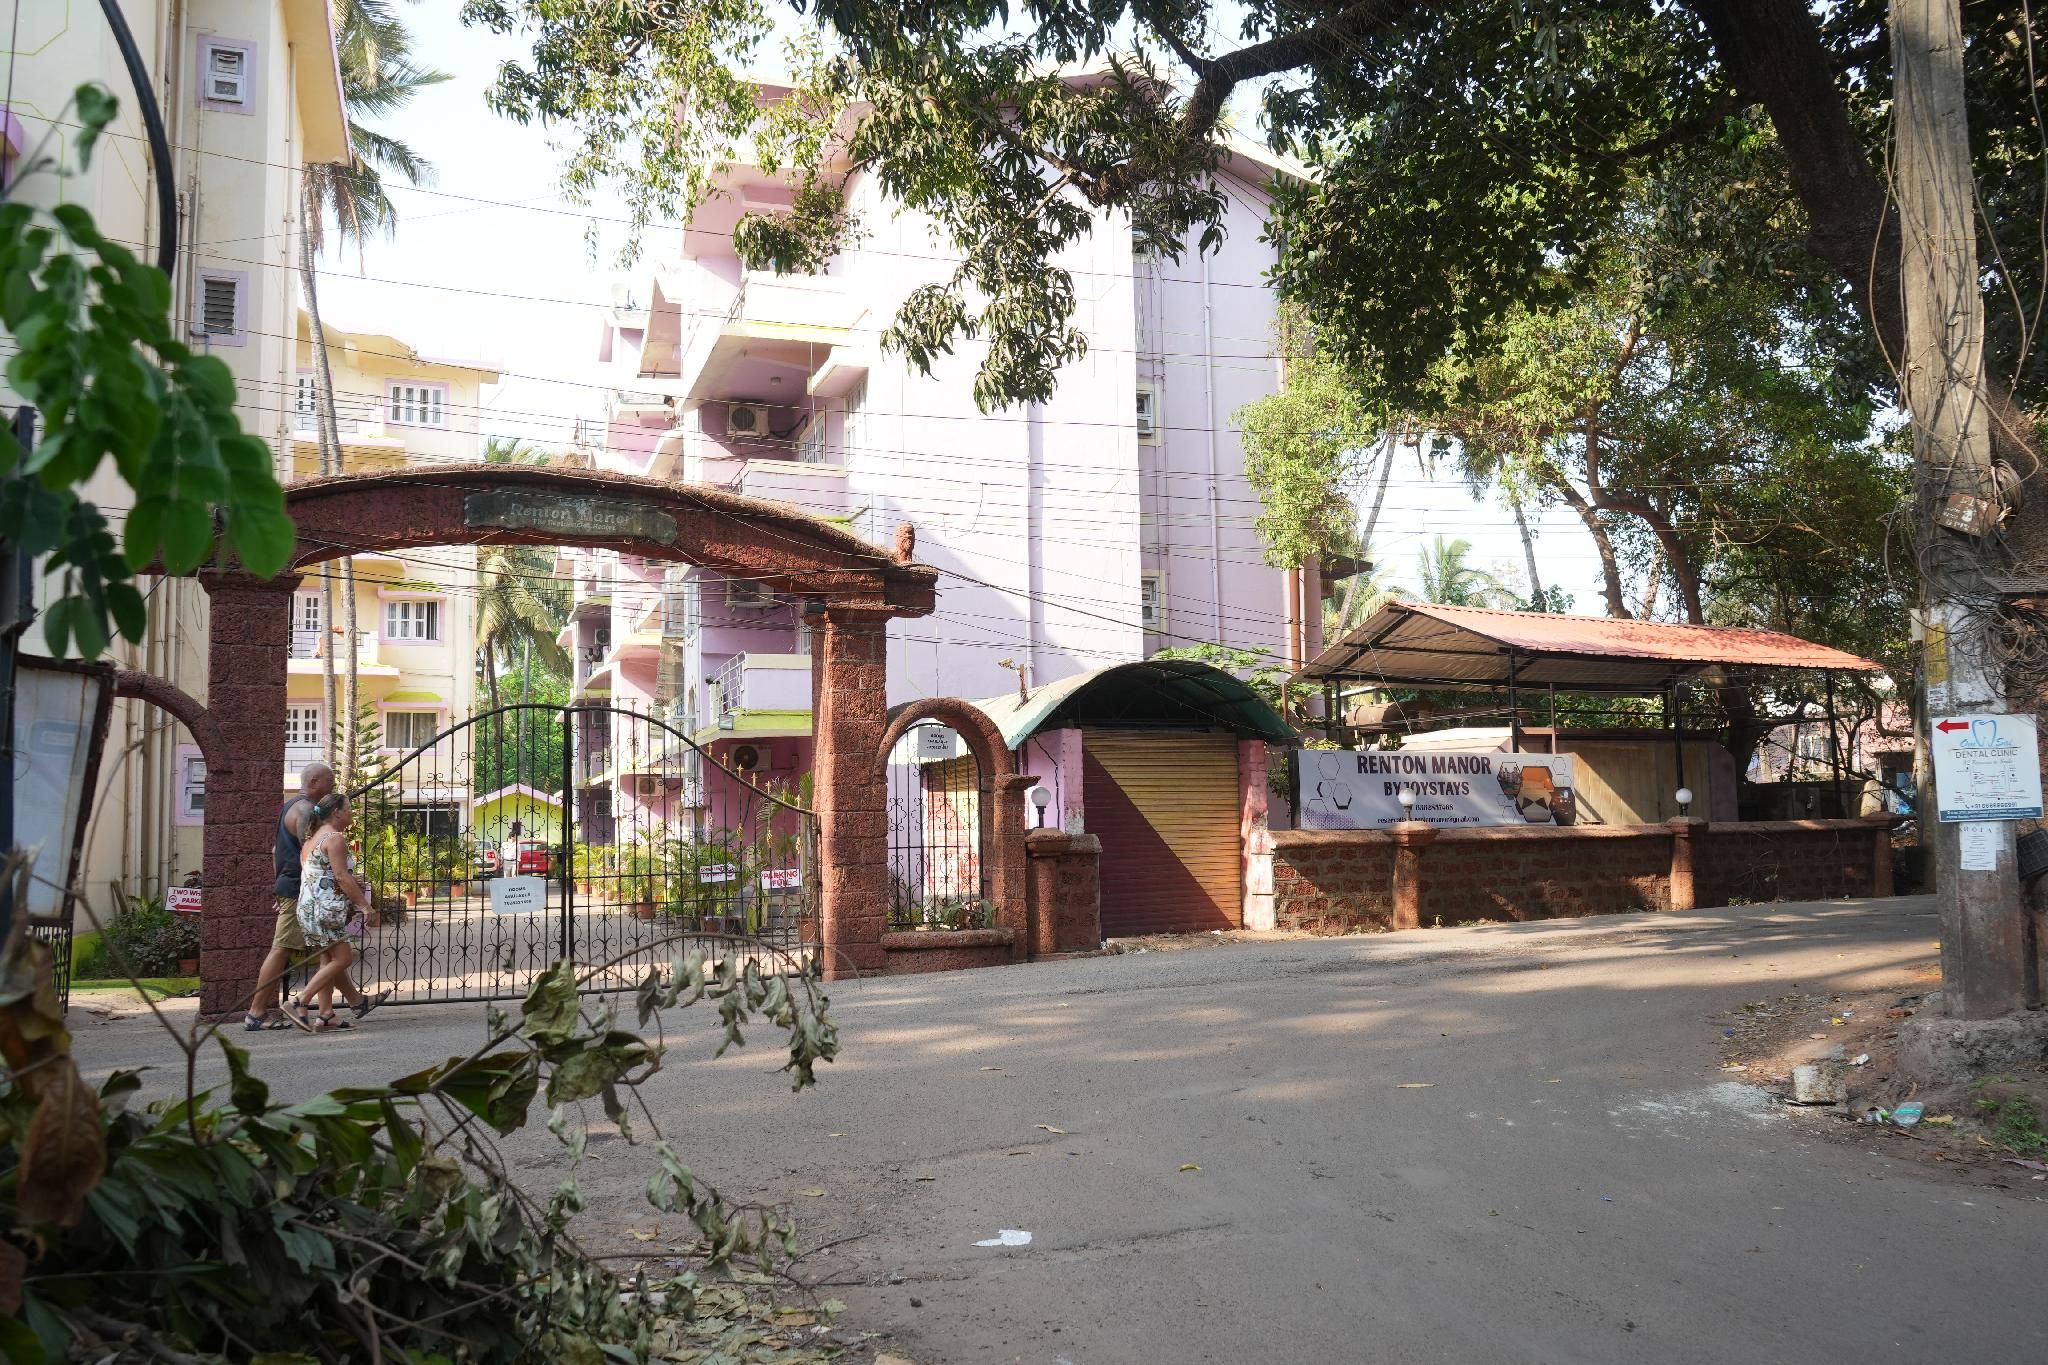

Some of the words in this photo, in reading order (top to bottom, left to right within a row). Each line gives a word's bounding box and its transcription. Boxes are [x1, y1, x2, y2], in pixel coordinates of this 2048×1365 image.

[511, 502, 571, 520] Renton
[1955, 750, 1988, 759] DENTAL
[1990, 749, 2018, 757] CLINIC
[1357, 755, 1427, 774] RENTON
[1431, 755, 1492, 774] MANOR
[1383, 781, 1401, 796] BY
[763, 870, 798, 880] PARKNG
